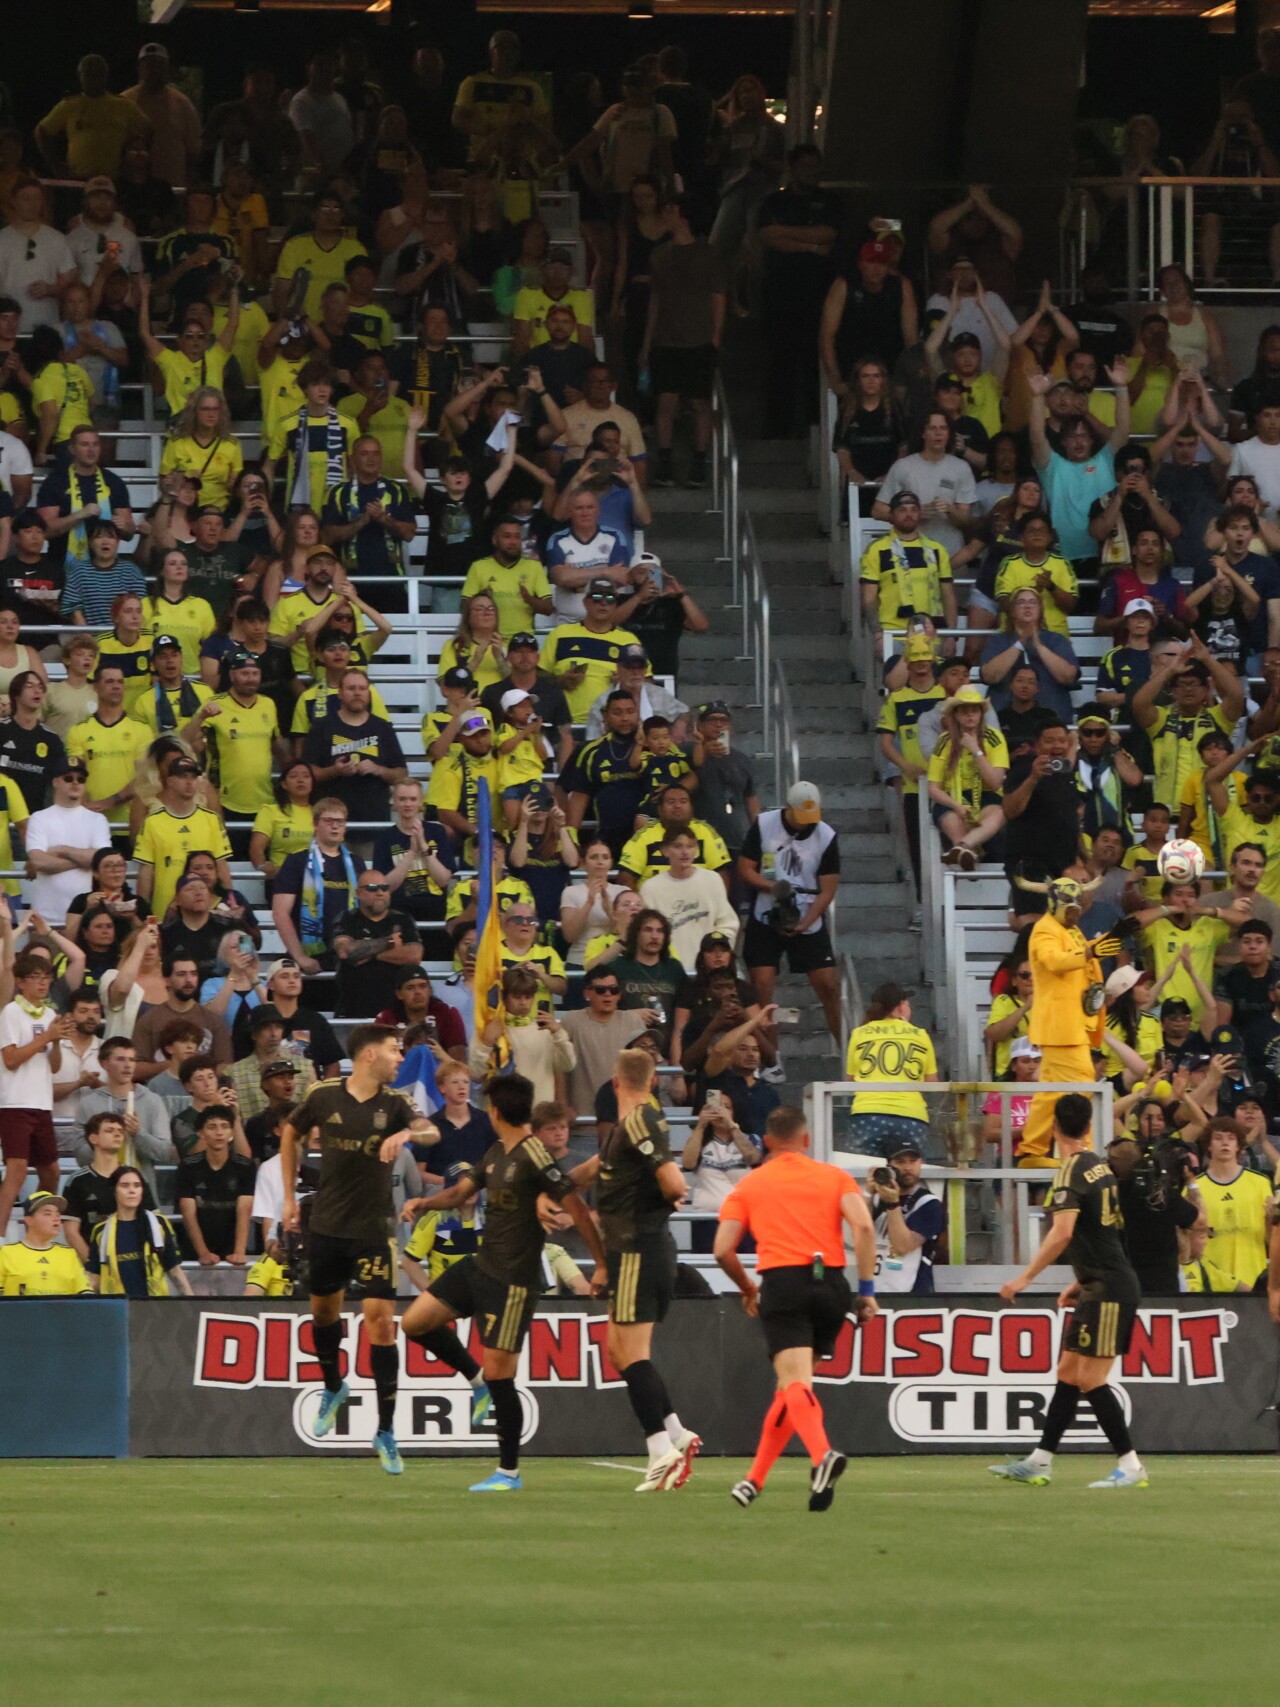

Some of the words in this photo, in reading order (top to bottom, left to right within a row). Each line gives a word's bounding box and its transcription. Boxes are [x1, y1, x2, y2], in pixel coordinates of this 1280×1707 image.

[855, 1040, 928, 1081] 305
[357, 1255, 390, 1281] 24
[484, 1312, 498, 1339] 7
[813, 1313, 1221, 1381] DISCONT
